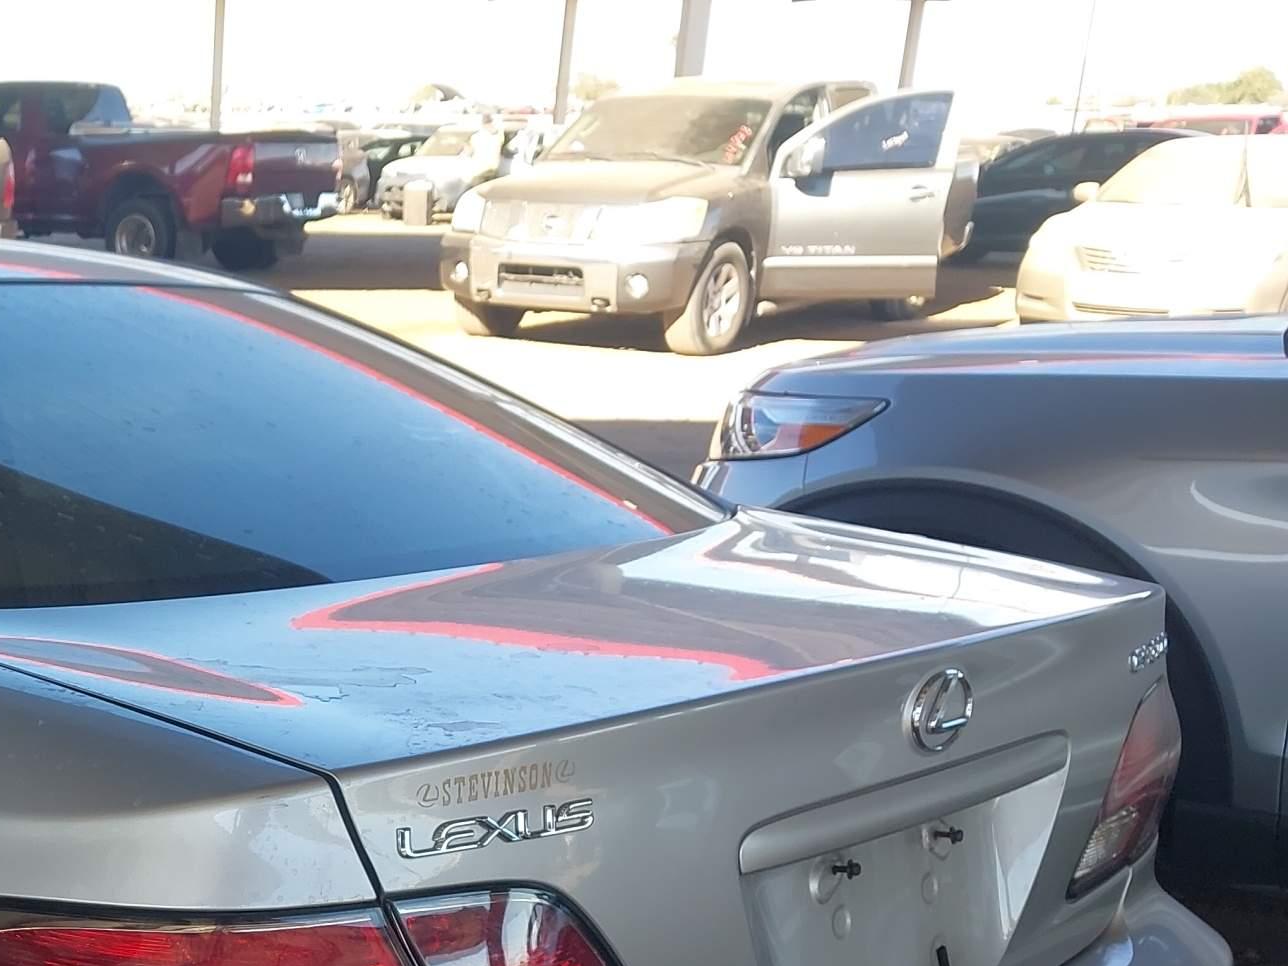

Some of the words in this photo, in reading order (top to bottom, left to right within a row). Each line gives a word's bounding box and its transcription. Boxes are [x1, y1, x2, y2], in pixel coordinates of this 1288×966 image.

[806, 244, 857, 256] TITAN
[441, 762, 553, 807] STEVINSON
[396, 798, 595, 860] LEXUS
